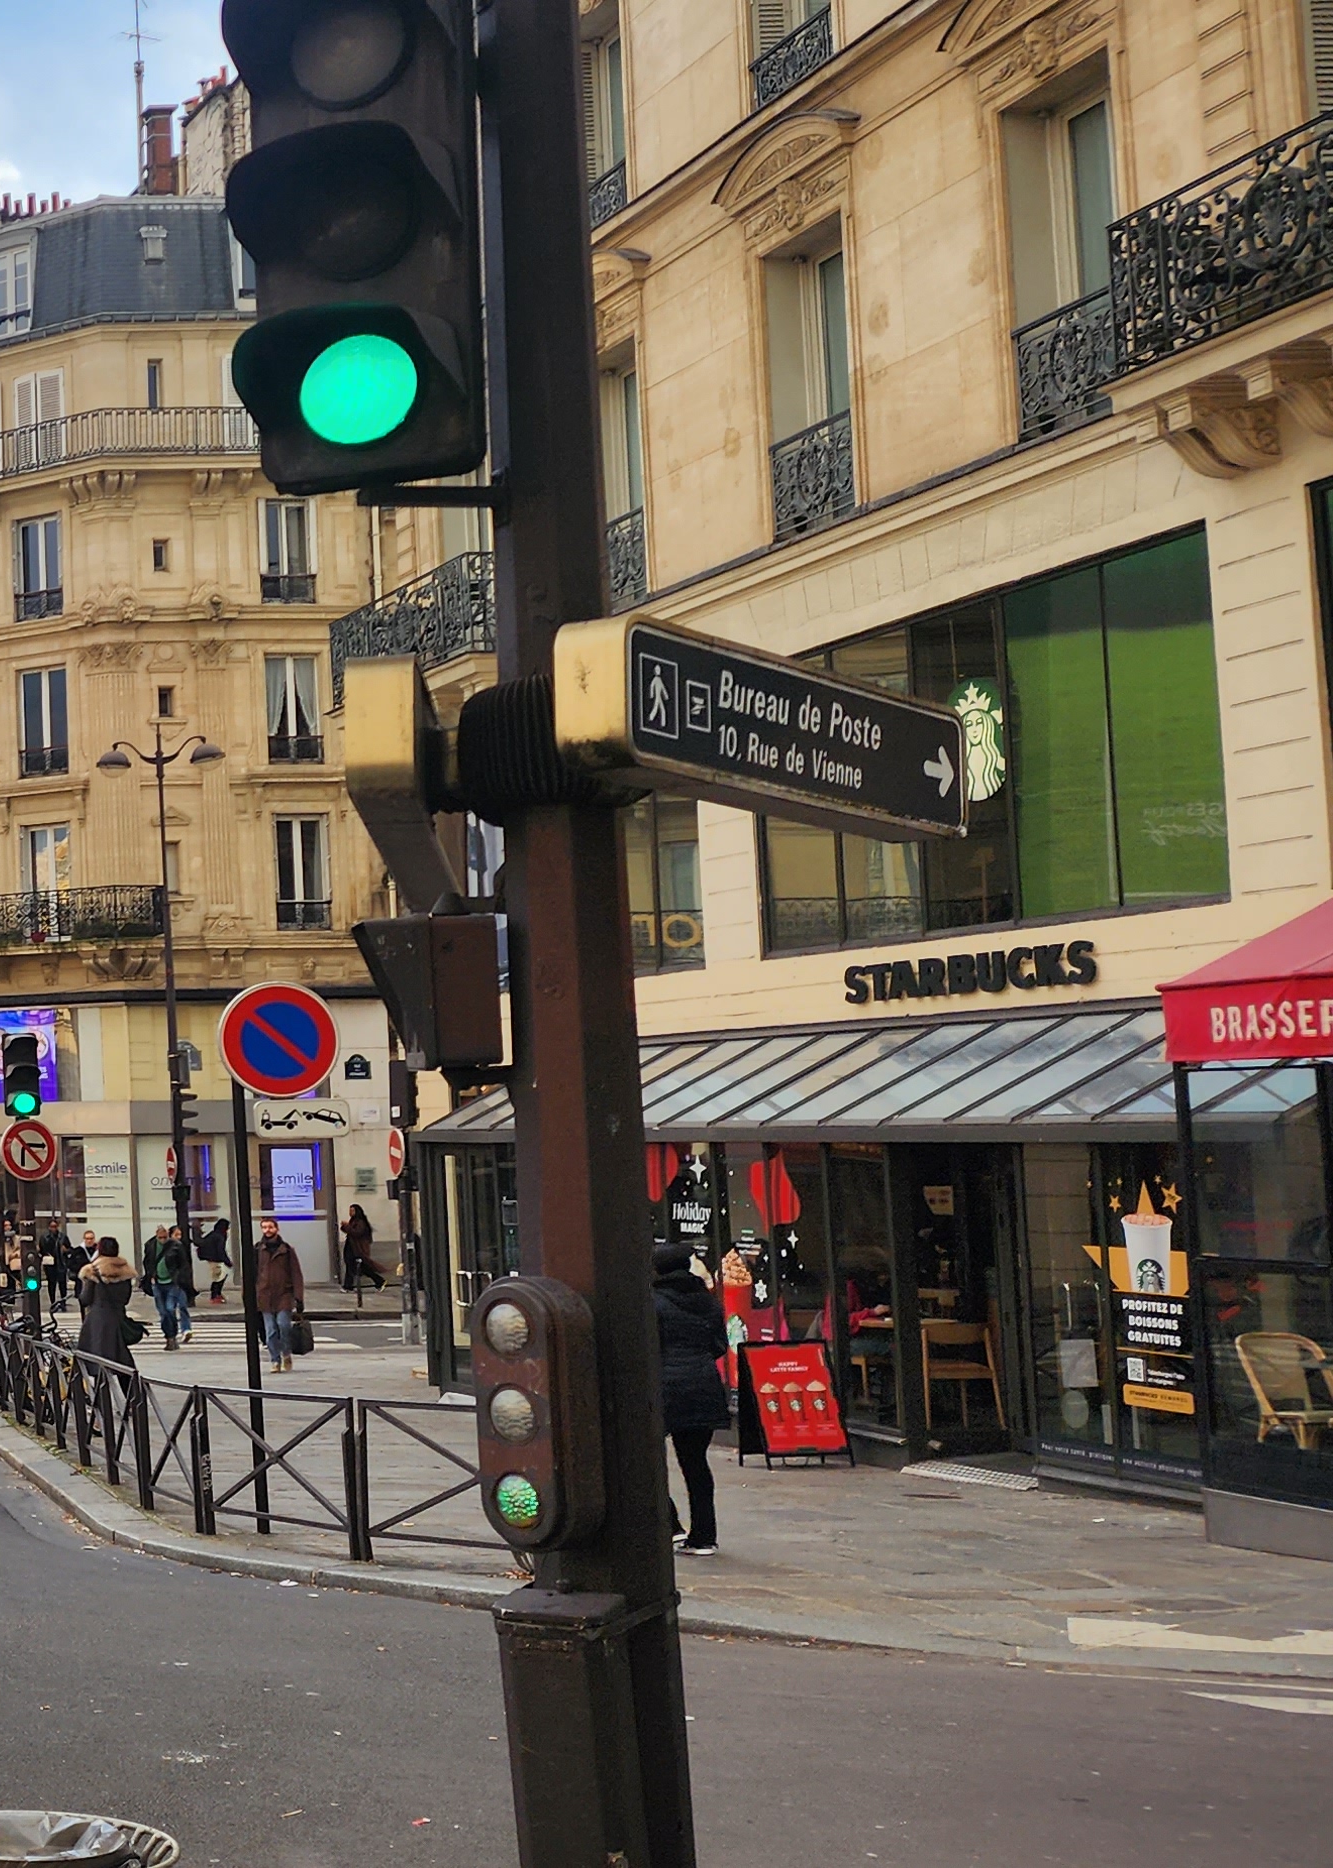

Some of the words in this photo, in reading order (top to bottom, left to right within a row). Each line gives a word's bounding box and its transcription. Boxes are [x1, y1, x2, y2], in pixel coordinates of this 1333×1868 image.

[717, 670, 790, 725] Bureau
[798, 694, 822, 733] de
[829, 702, 882, 751] Poste
[718, 724, 742, 761] 10,
[747, 732, 779, 769] Rue
[785, 743, 805, 775] de
[812, 748, 863, 790] Vienne
[844, 940, 1098, 1005] STARBUCKS
[86, 1162, 128, 1174] esmile
[672, 1202, 712, 1225] Holiday
[680, 1222, 705, 1234] MAGIC
[1121, 1299, 1169, 1314] PROFITEZ
[1169, 1303, 1184, 1315] DE
[1128, 1315, 1179, 1331] BOISSONS
[1127, 1330, 1182, 1347] GRATUITES
